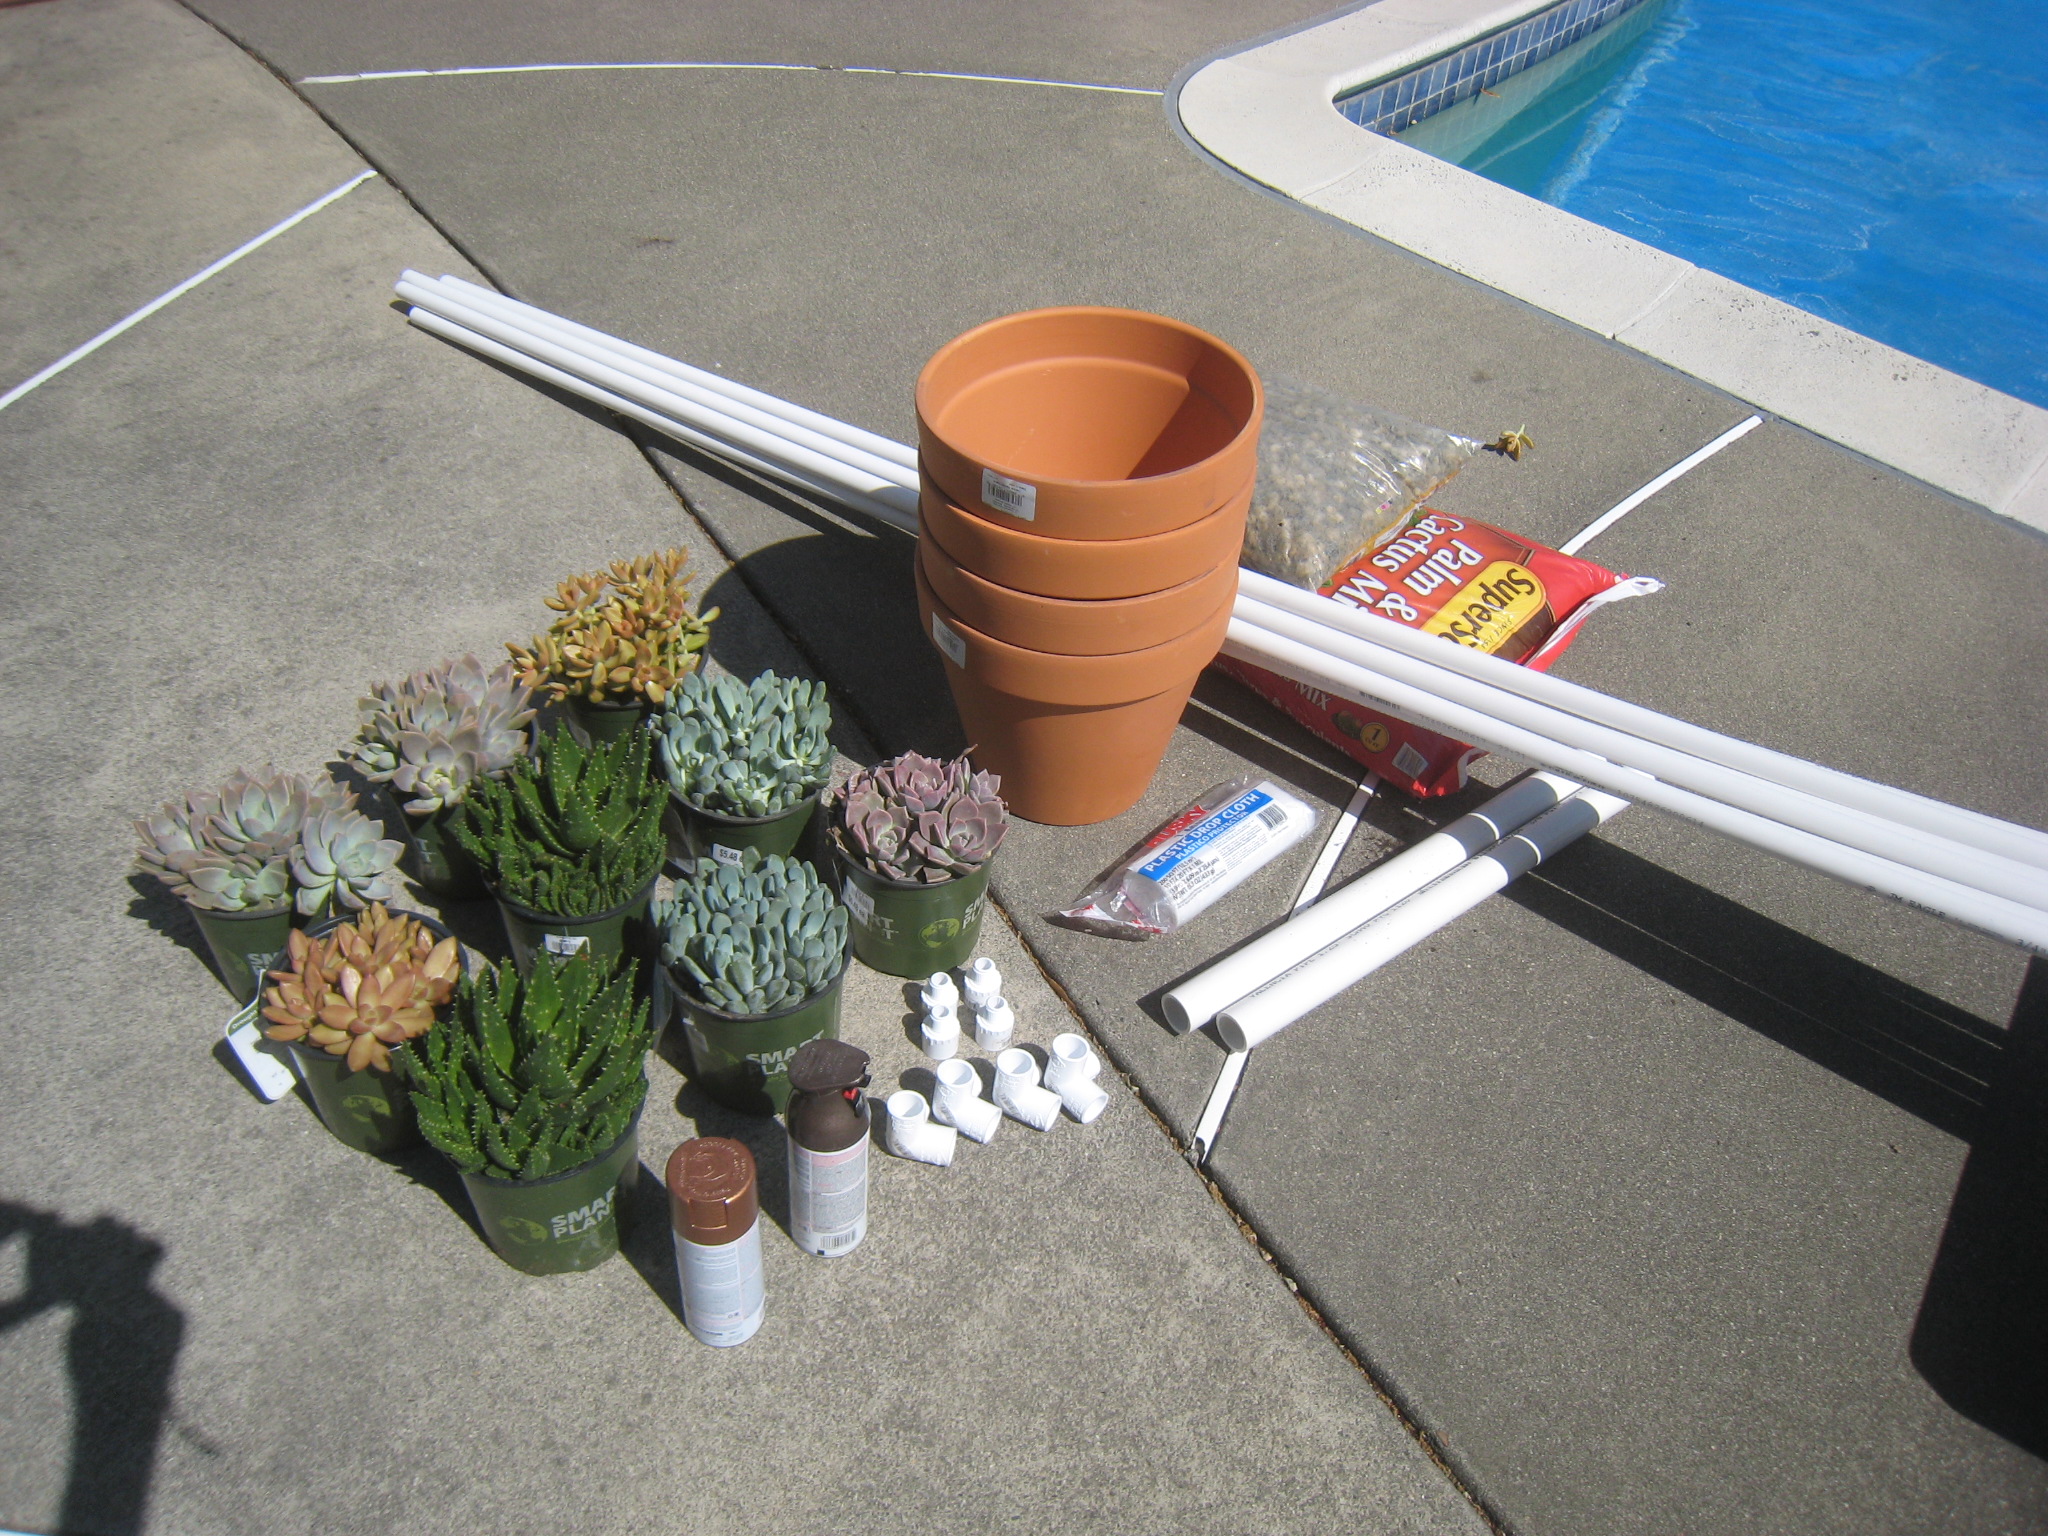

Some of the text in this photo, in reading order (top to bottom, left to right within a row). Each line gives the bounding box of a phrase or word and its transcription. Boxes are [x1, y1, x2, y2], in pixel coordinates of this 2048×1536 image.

[1331, 514, 1465, 613] Cactus Mi
[1375, 539, 1484, 622] Palm &
[1145, 834, 1192, 871] PLASTIC
[1191, 816, 1222, 838] DROP
[1221, 792, 1259, 820] CLOTH
[1175, 834, 1210, 859] PLASTICO
[1208, 810, 1248, 837] PROTECTOR
[1908, 899, 1946, 919] EAGLE
